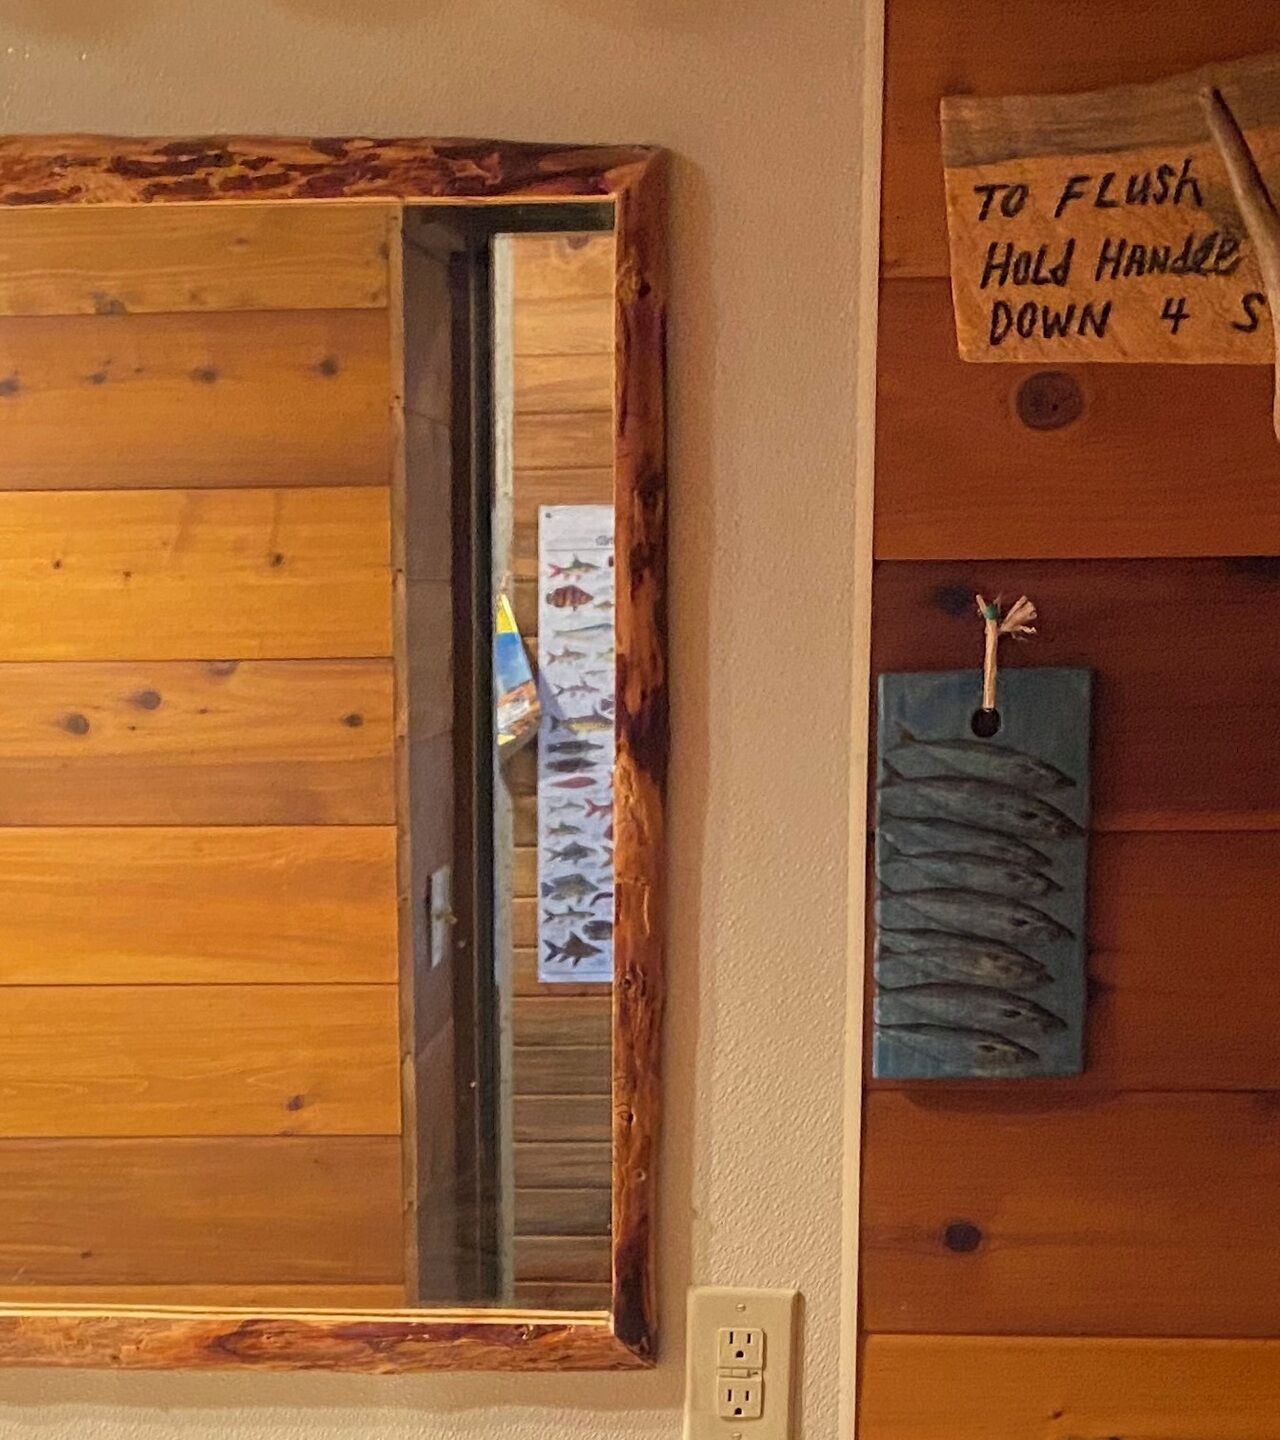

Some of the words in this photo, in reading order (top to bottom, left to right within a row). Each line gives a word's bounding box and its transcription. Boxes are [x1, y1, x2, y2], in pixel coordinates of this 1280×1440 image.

[973, 183, 1029, 221] TO
[989, 299, 1113, 346] DOWN
[1160, 297, 1191, 335] 4
